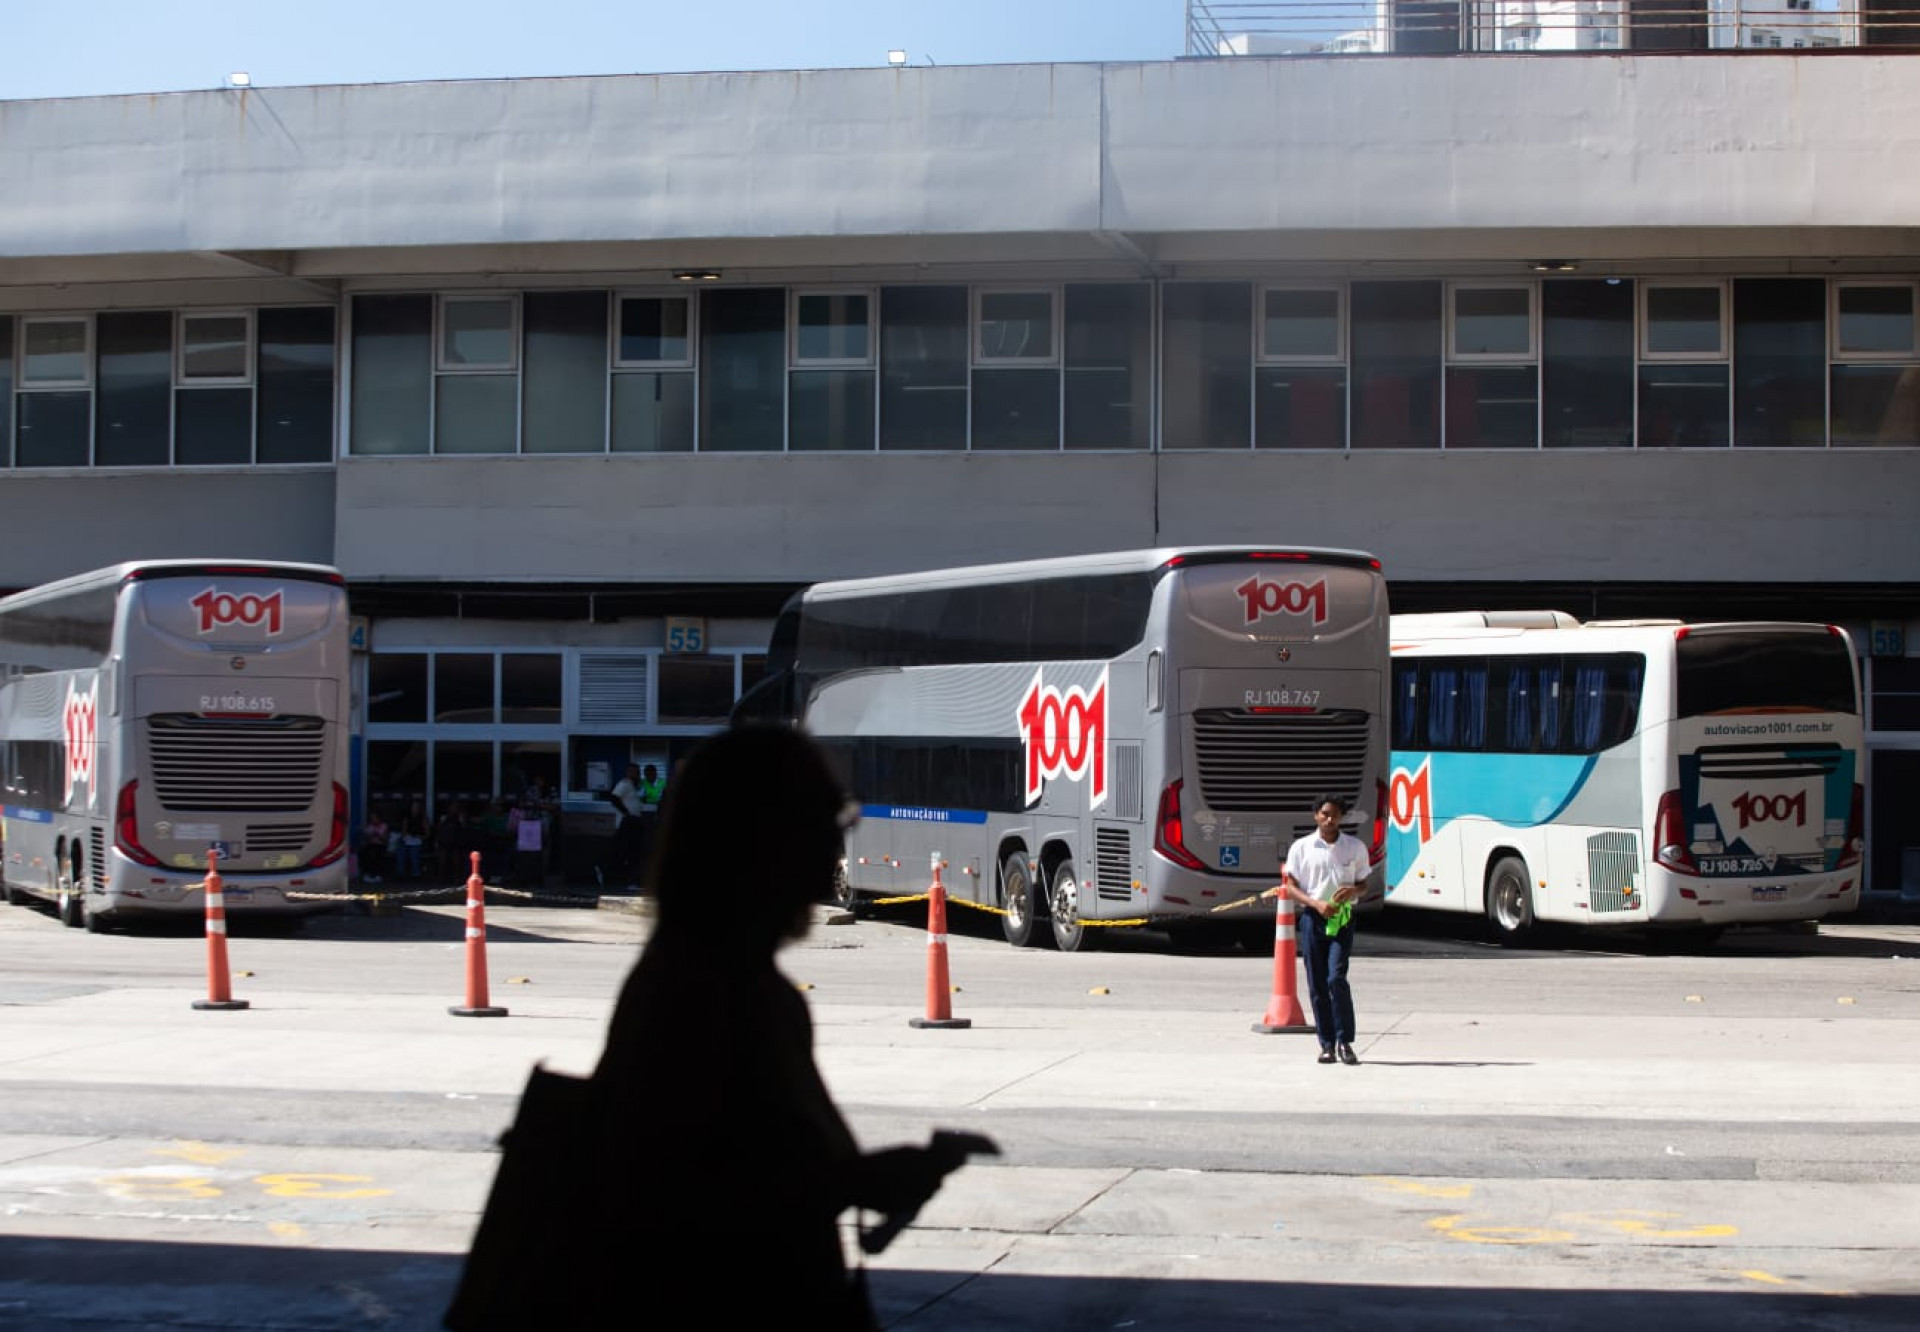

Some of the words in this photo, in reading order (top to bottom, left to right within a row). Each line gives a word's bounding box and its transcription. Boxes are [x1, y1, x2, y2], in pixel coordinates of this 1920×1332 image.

[191, 586, 284, 635] 1001
[1234, 572, 1328, 626] 1001
[350, 626, 365, 646] 4
[670, 627, 701, 651] 55
[1875, 628, 1900, 653] 58
[200, 697, 217, 710] RJ
[220, 697, 275, 710] 108.615
[1245, 691, 1262, 704] RJ
[1264, 690, 1320, 704] 108.767
[1017, 666, 1109, 810] 1001
[1703, 721, 1834, 736] autoviacao1001.com.br
[63, 674, 98, 810] 1001
[1389, 754, 1433, 845] 01
[1732, 789, 1807, 829] 1001
[1701, 861, 1716, 874] RJ
